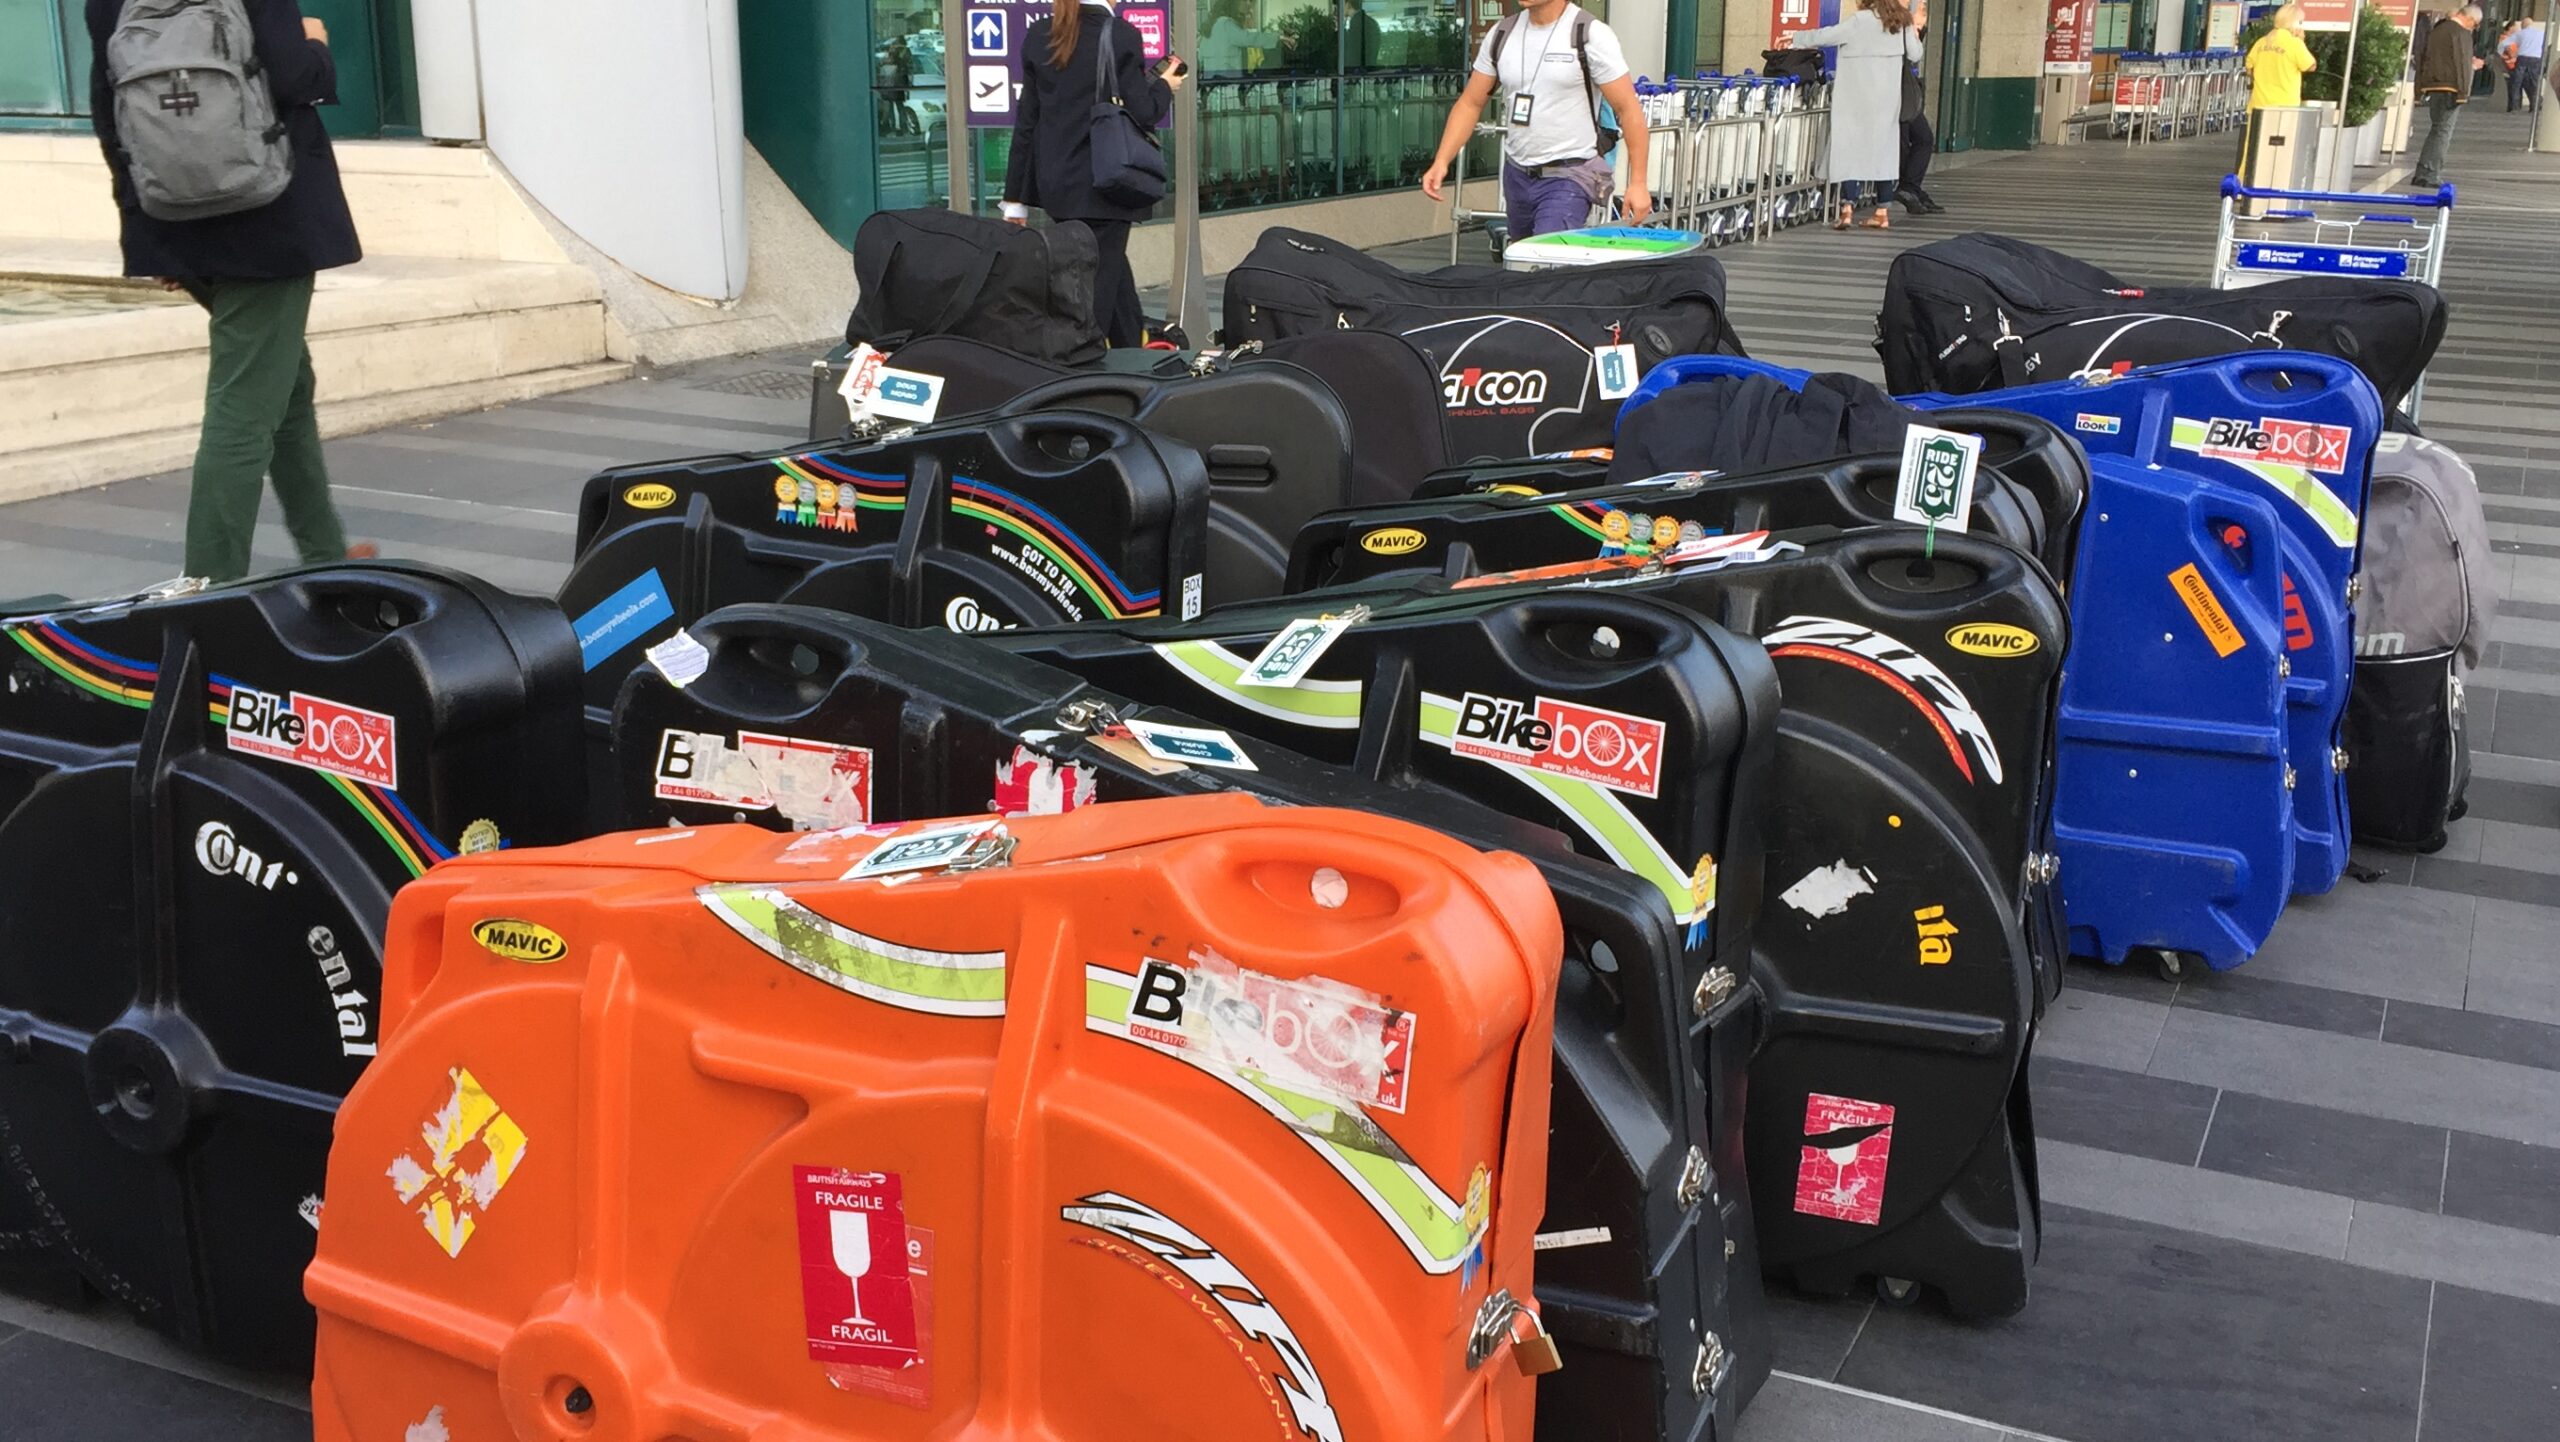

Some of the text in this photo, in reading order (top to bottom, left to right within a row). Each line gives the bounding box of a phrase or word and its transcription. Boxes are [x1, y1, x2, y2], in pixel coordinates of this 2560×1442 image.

[1128, 14, 1159, 25] Airport
[1500, 406, 1535, 415] BAGS
[2077, 421, 2106, 432] LOOK
[1926, 448, 1959, 467] RIDE
[1924, 463, 1956, 507] 25
[632, 491, 667, 502] MAVIC
[1371, 535, 1416, 548] MAVIC
[1021, 544, 1078, 597] GOT TO TRI
[1184, 577, 1201, 593] BOX
[1186, 597, 1198, 616] 15
[2183, 573, 2230, 635] Continental
[1961, 631, 2024, 650] MAVIC
[488, 928, 553, 955] MAVIC
[1132, 1025, 1147, 1037] 00
[1147, 1028, 1162, 1041] 44
[1820, 1110, 1876, 1126] FRAGILE
[807, 1174, 838, 1186] BRITISH
[815, 1190, 884, 1211] FRAGILE
[831, 1324, 893, 1344] FRAGIL
